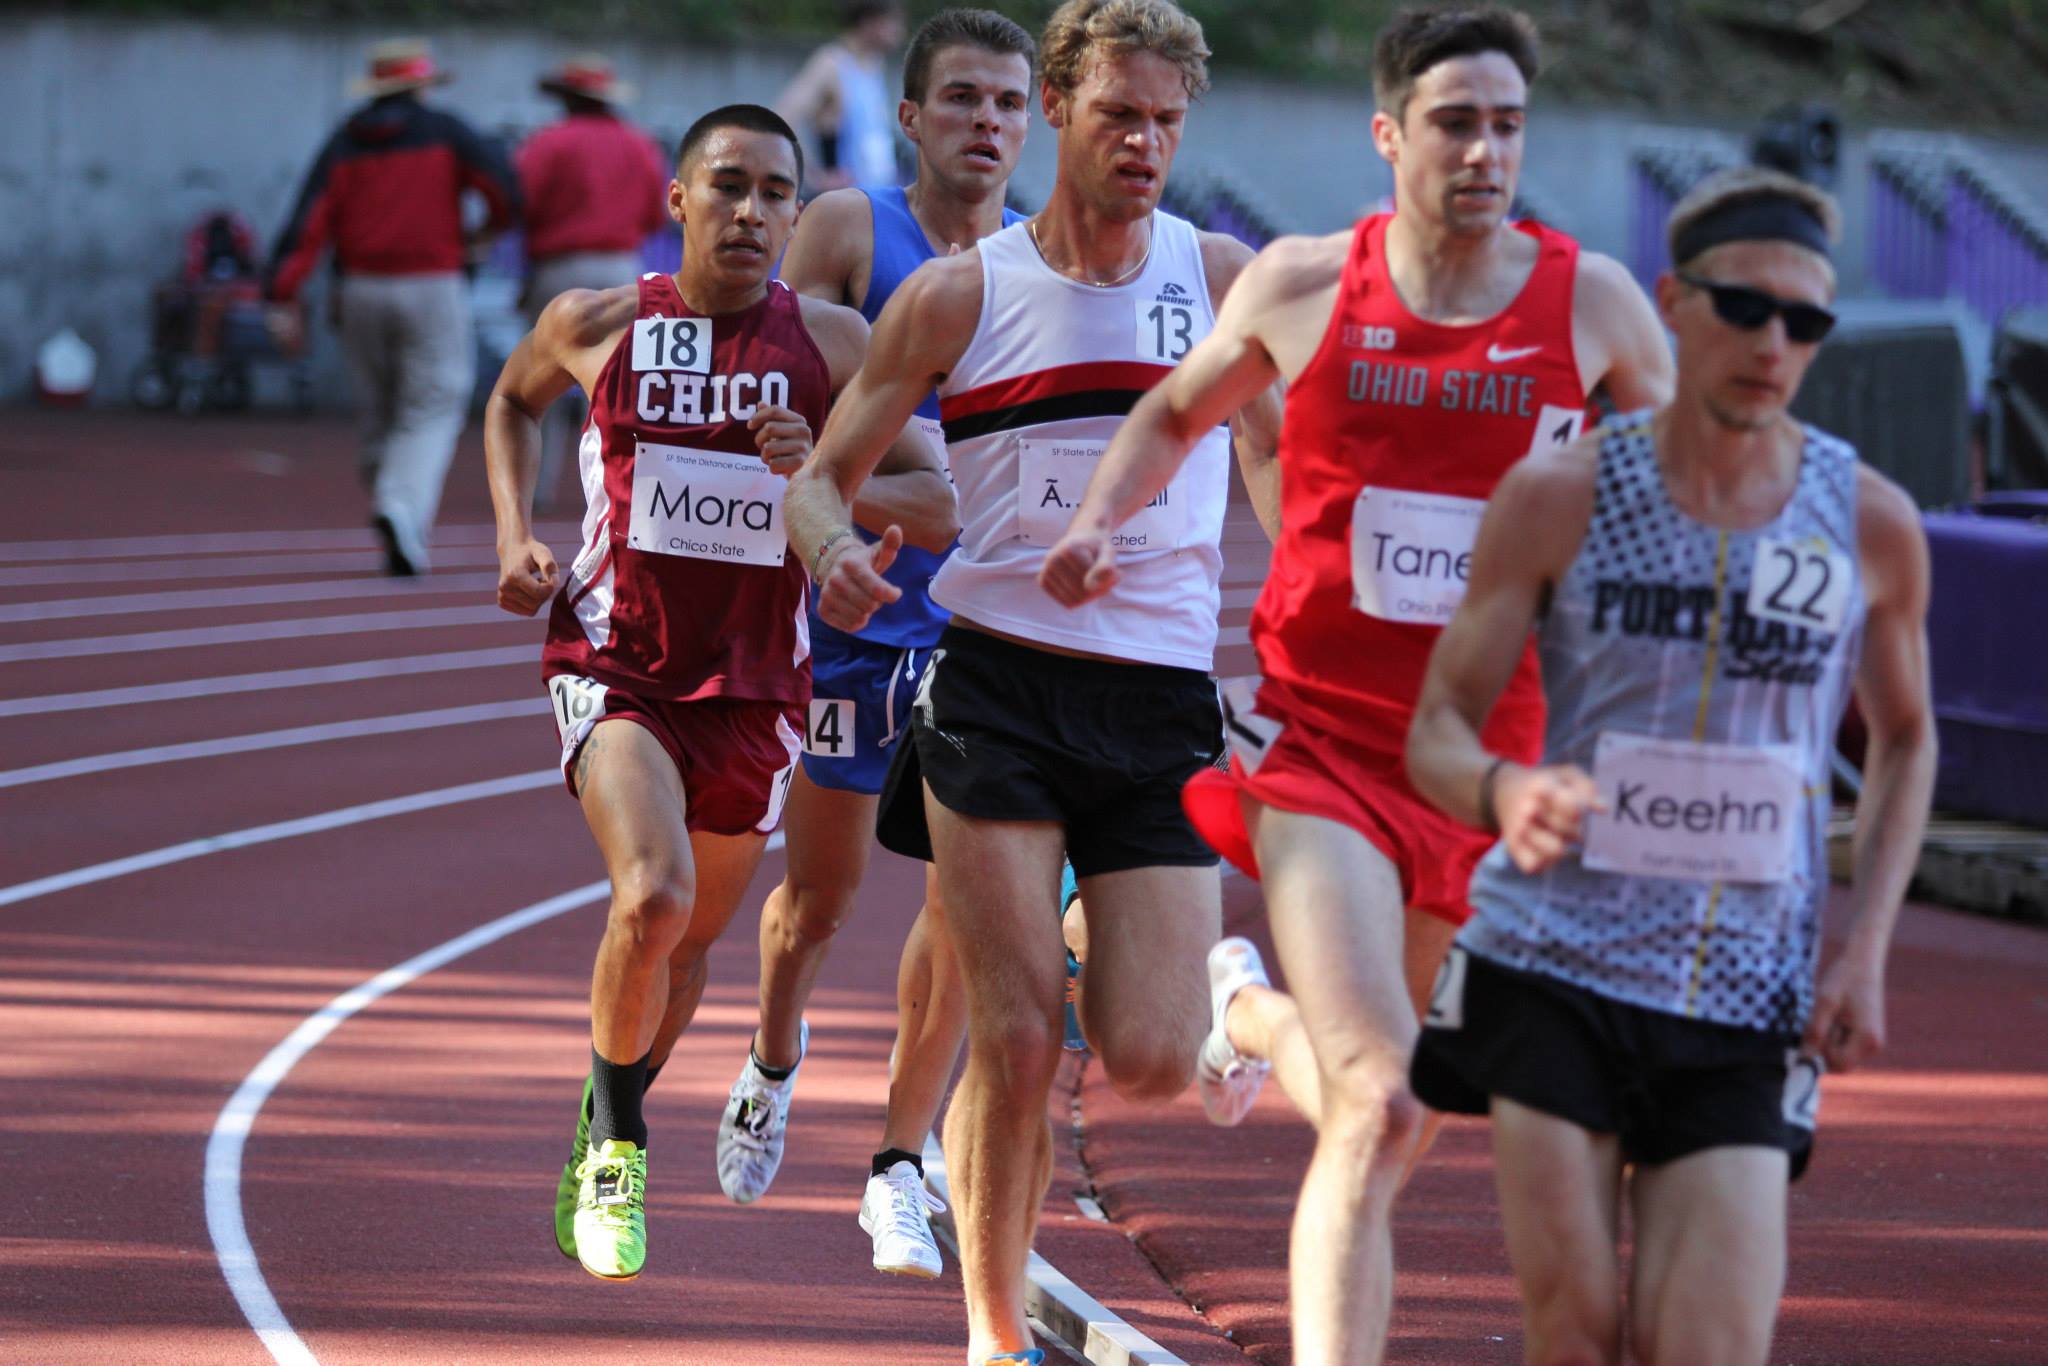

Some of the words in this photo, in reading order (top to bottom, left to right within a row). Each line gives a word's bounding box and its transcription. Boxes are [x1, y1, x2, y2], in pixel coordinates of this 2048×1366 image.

[647, 320, 698, 367] 18
[1147, 304, 1193, 361] 13
[637, 371, 789, 424] CHICO
[1347, 360, 1429, 406] OHIO
[1439, 369, 1537, 417] STATE
[665, 454, 675, 462] SF
[676, 455, 697, 465] State
[698, 458, 734, 469] Distance
[1062, 448, 1085, 456] State
[649, 481, 773, 531] Mora
[669, 537, 709, 554] Chico
[711, 541, 745, 558] State
[1372, 532, 1472, 581] Tane
[1590, 580, 1716, 639] FORT
[1764, 547, 1832, 622] 22
[1613, 780, 1781, 834] Keehn
